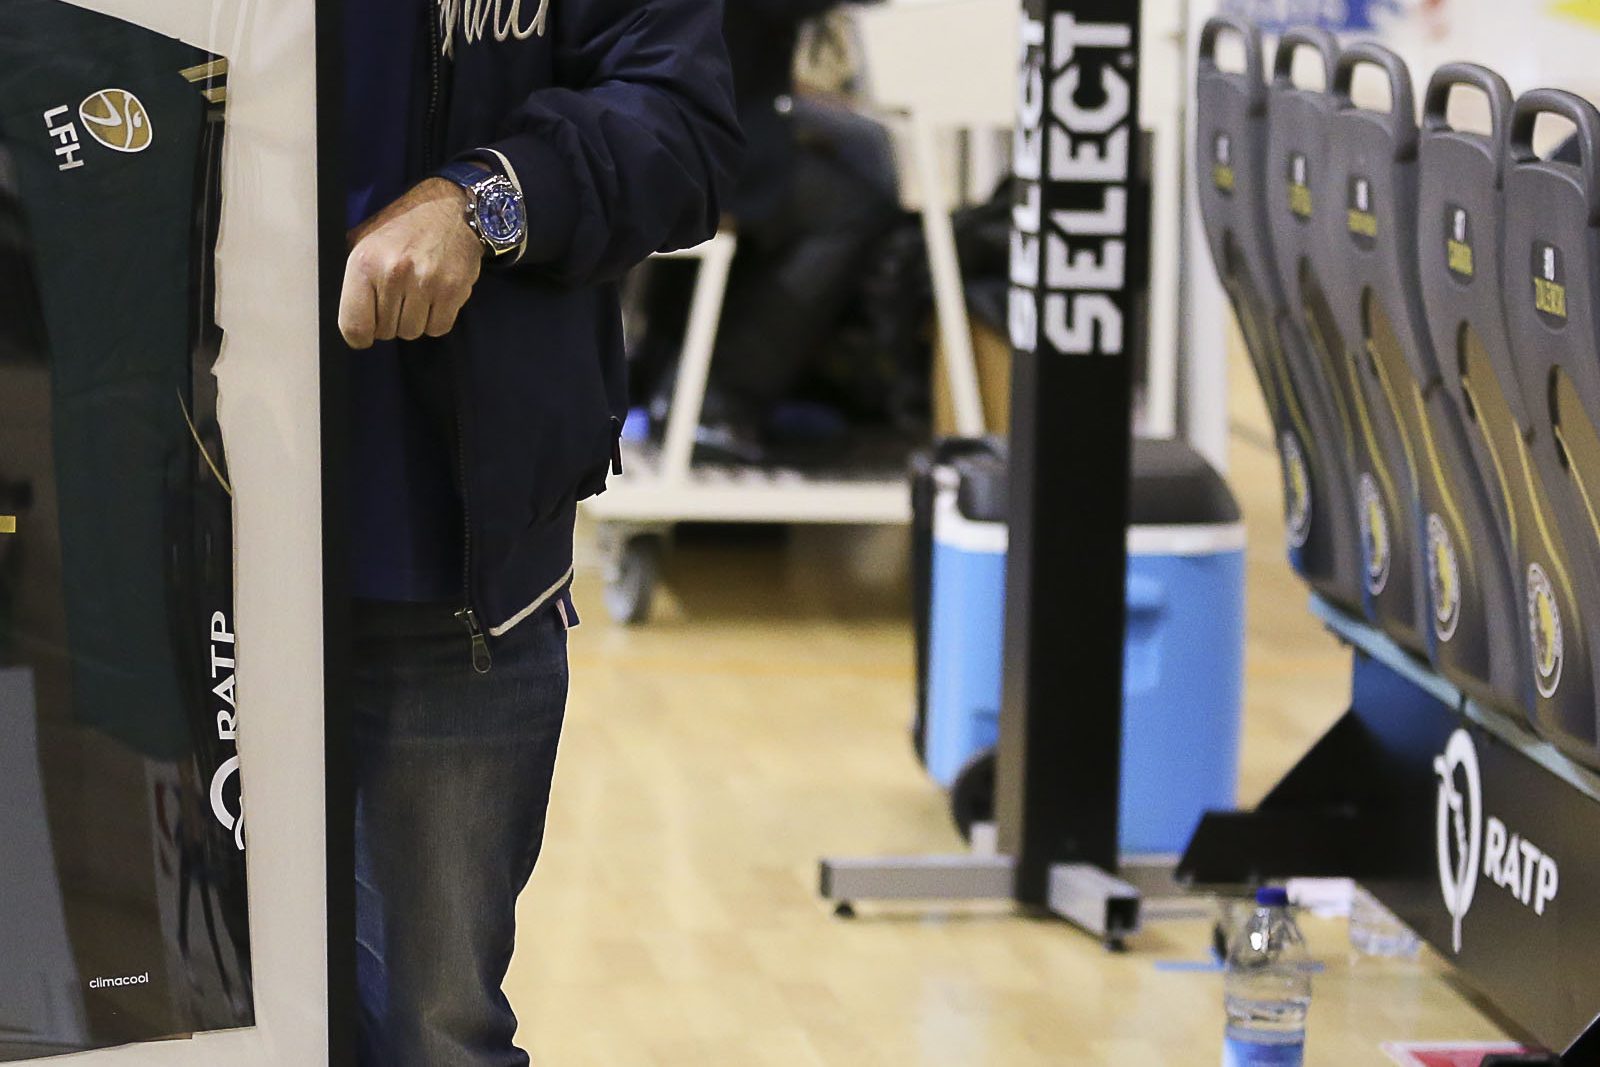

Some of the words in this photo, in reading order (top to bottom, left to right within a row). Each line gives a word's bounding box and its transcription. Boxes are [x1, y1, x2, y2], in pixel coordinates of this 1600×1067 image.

[43, 104, 84, 171] LFH
[1043, 10, 1132, 355] SELECT
[210, 610, 237, 740] RATP
[1483, 815, 1560, 917] RATP
[88, 971, 149, 990] climacool
